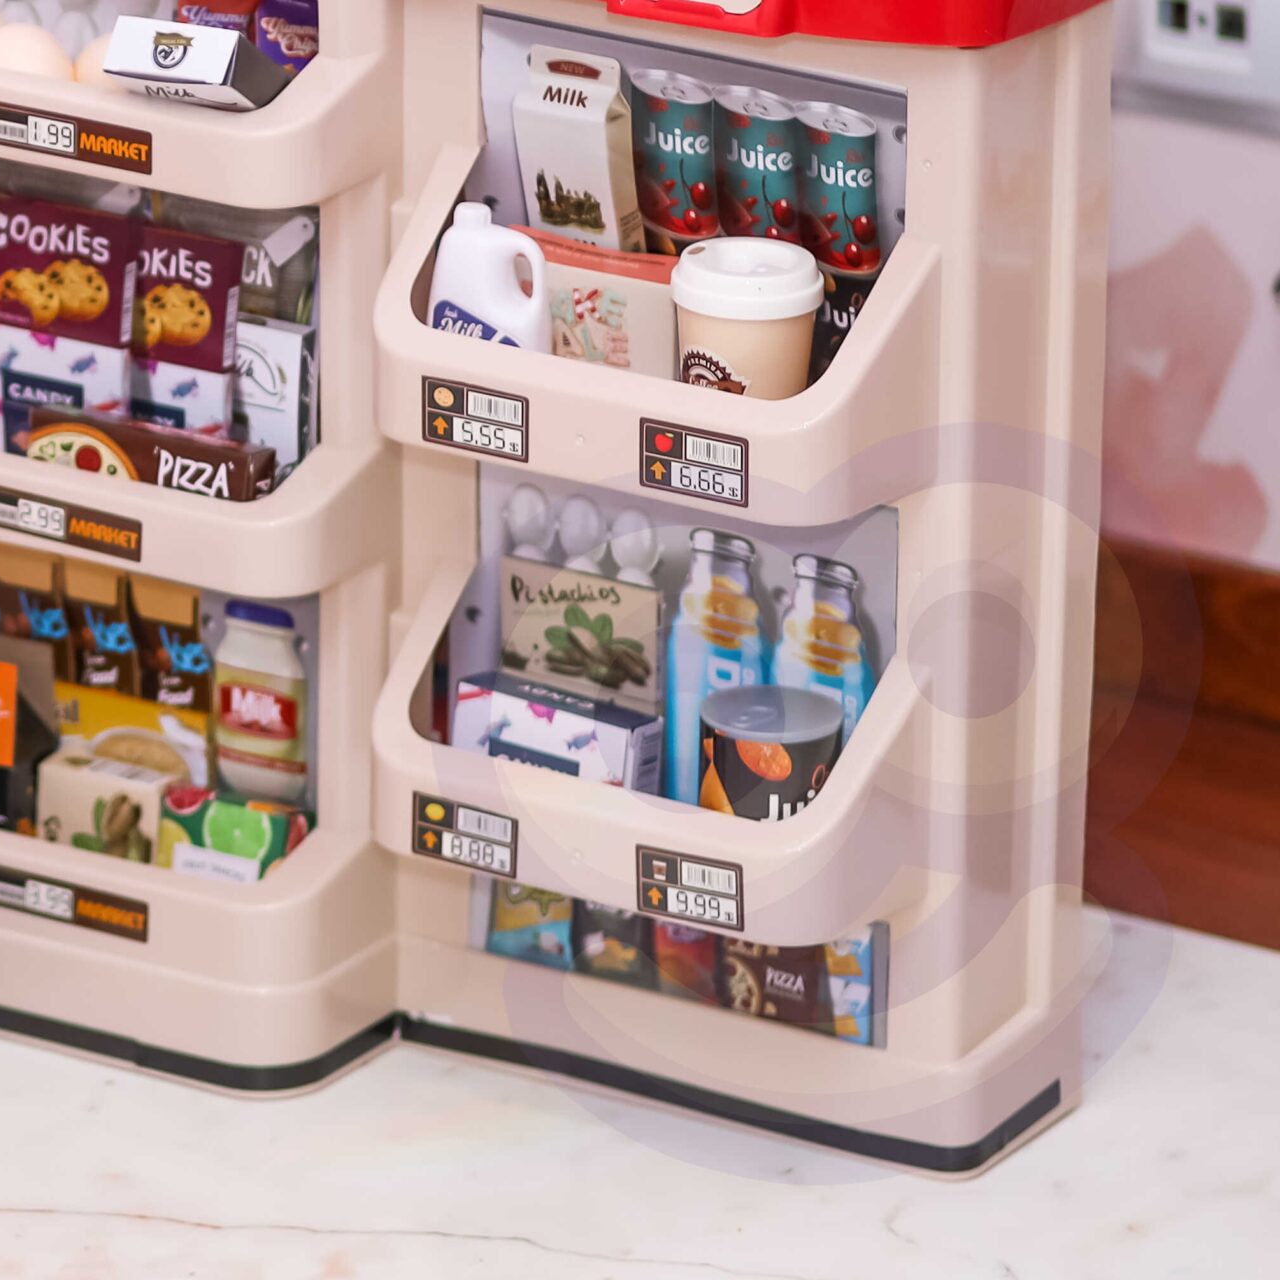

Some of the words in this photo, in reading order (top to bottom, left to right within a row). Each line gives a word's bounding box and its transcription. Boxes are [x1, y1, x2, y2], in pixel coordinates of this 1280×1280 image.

[559, 62, 587, 75] NEW
[542, 85, 589, 109] Milk
[31, 121, 73, 149] 1.99
[79, 132, 149, 162] MARKET
[644, 121, 711, 156] Juice
[726, 137, 794, 172] Juice
[806, 153, 874, 189] Juice
[8, 382, 75, 406] CANDY
[20, 502, 64, 533] 2.99
[69, 517, 139, 550] MARKET
[230, 686, 283, 726] Milk
[766, 966, 806, 994] PIZZA
